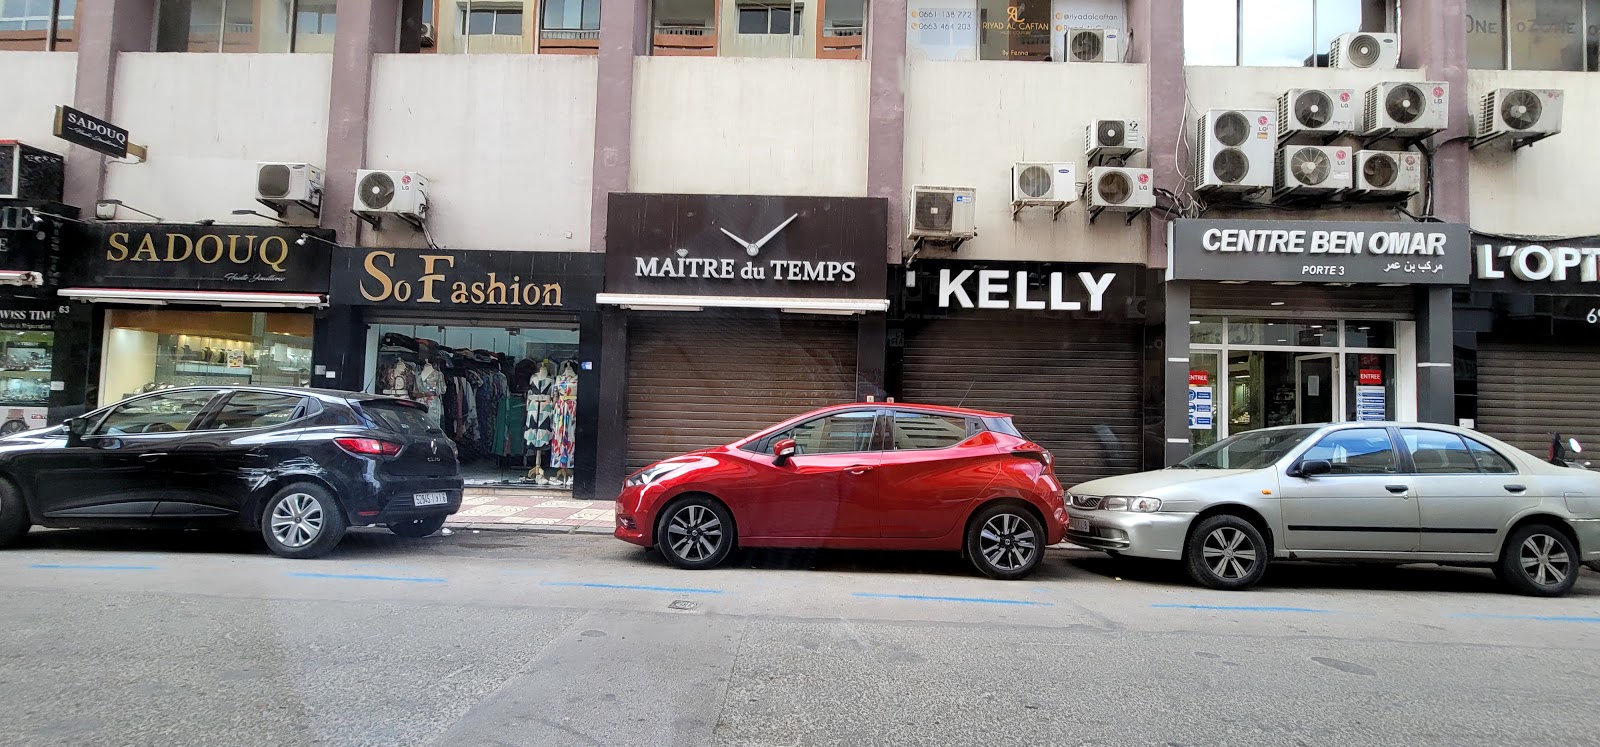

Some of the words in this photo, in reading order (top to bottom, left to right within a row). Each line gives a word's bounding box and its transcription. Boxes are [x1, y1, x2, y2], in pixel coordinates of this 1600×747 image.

[982, 22, 1004, 30] RIYAD
[1006, 22, 1016, 30] AL
[1018, 22, 1049, 30] CAFTAN
[67, 112, 126, 146] SADOUQ
[1202, 228, 1307, 253] CENTRE
[1310, 230, 1365, 254] BEN
[1368, 231, 1447, 256] OMAR
[106, 232, 289, 272] SADOUQ
[740, 261, 765, 280] du
[770, 259, 856, 282] TEMPS
[1301, 265, 1337, 275] PORTE
[1338, 265, 1345, 275] 3
[1383, 262, 1401, 273] عمر
[1404, 261, 1416, 272] بن
[1417, 261, 1443, 274] مركب
[359, 250, 412, 302] So
[416, 254, 563, 306] Fashion
[938, 268, 1117, 311] KELLY
[59, 306, 70, 314] 63
[1586, 307, 1600, 324] 6
